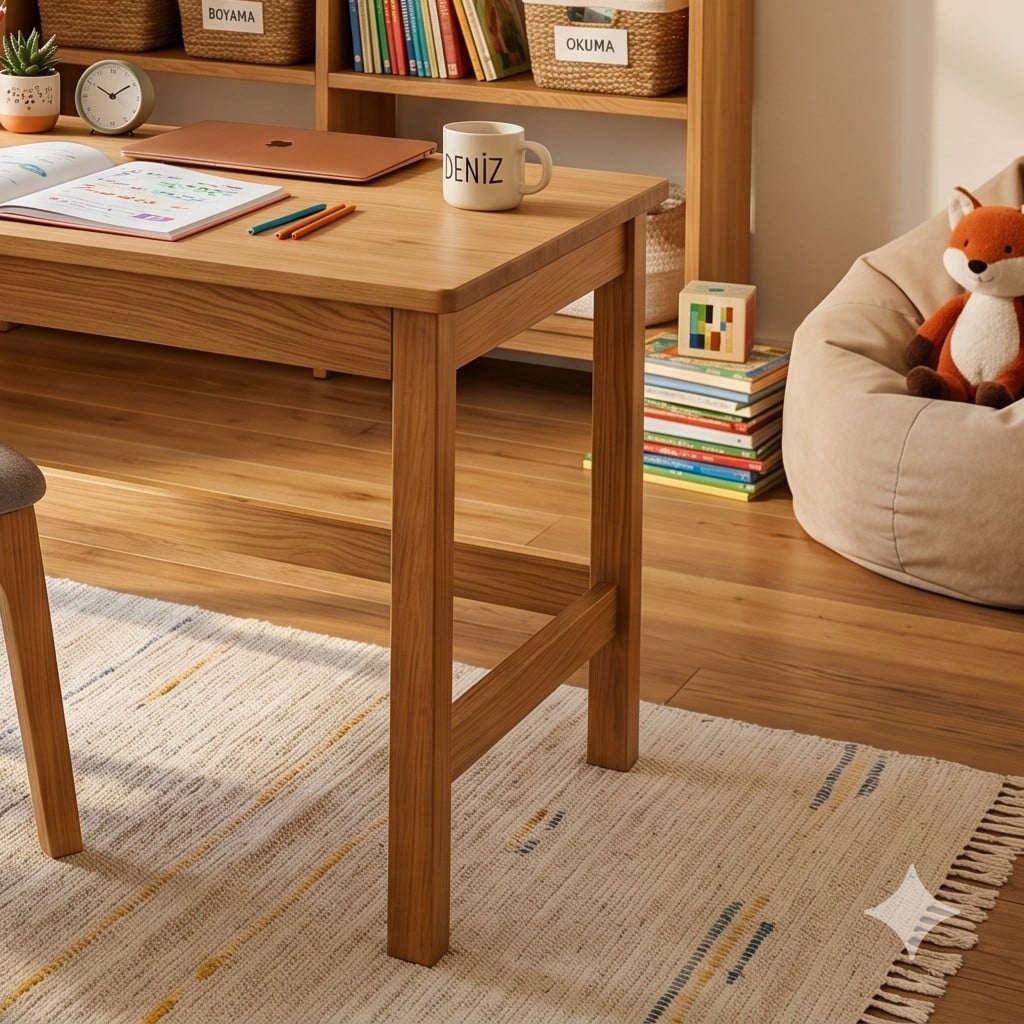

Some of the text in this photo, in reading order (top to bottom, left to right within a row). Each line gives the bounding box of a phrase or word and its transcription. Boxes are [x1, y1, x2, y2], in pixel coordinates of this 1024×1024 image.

[208, 7, 255, 23] BOYAMA
[566, 37, 615, 53] OKUMA
[445, 152, 504, 185] DENİZ
